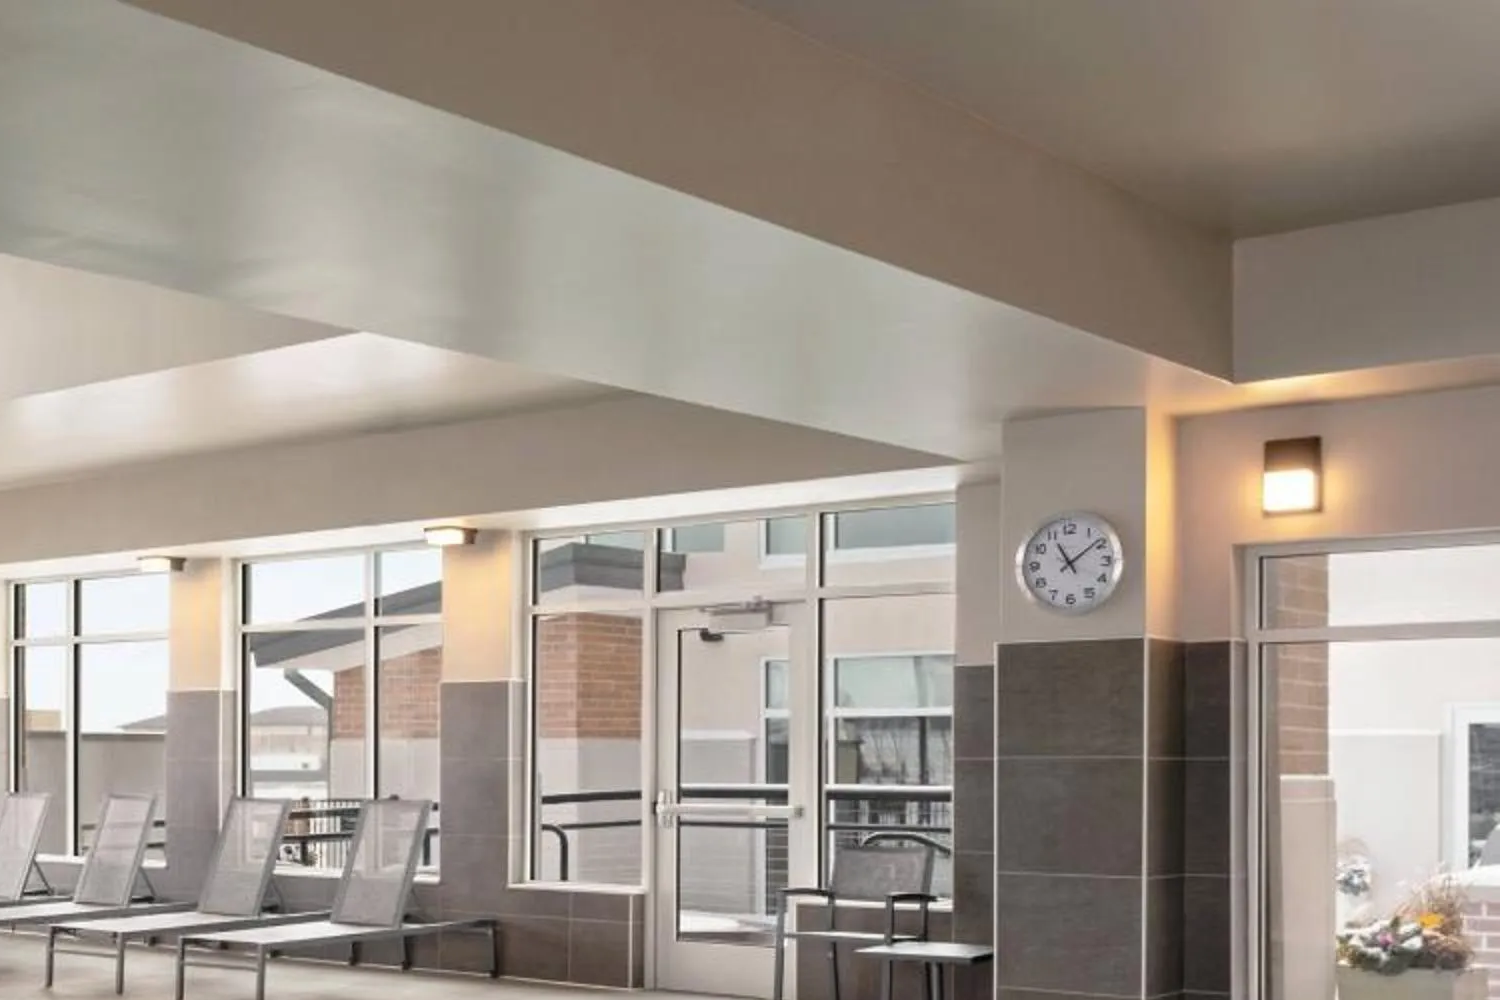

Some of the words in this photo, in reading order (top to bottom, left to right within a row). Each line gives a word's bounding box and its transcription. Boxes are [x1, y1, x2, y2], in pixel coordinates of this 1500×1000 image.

[1063, 522, 1077, 535] 12
[1047, 531, 1058, 541] 11
[1035, 543, 1046, 554] 10
[1095, 537, 1106, 549] 2
[1101, 555, 1112, 566] 3
[1029, 561, 1040, 572] 9
[1036, 577, 1046, 588] 8
[1097, 573, 1107, 583] 4
[1048, 588, 1059, 600] 7
[1084, 587, 1095, 598] 5
[1065, 593, 1077, 605] 6
